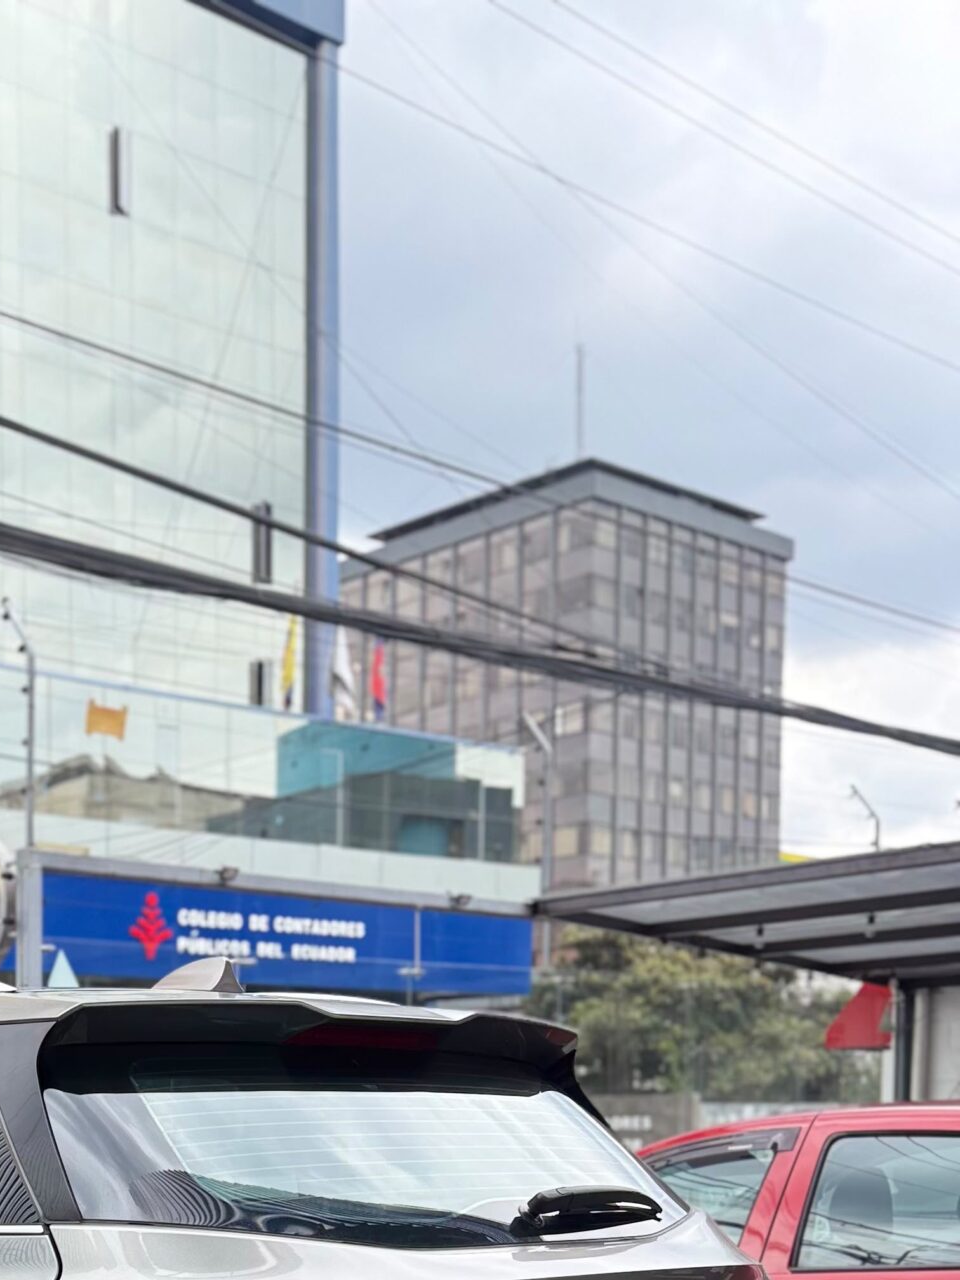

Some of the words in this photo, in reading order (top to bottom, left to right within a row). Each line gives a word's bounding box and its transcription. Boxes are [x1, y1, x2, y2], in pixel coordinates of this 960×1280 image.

[176, 907, 244, 931] COLEGIO
[248, 913, 270, 933] DE
[272, 914, 367, 940] CONTADORES
[175, 928, 251, 957] PÚBLICOS
[254, 939, 285, 960] DEL
[290, 942, 357, 964] ECUADOR
